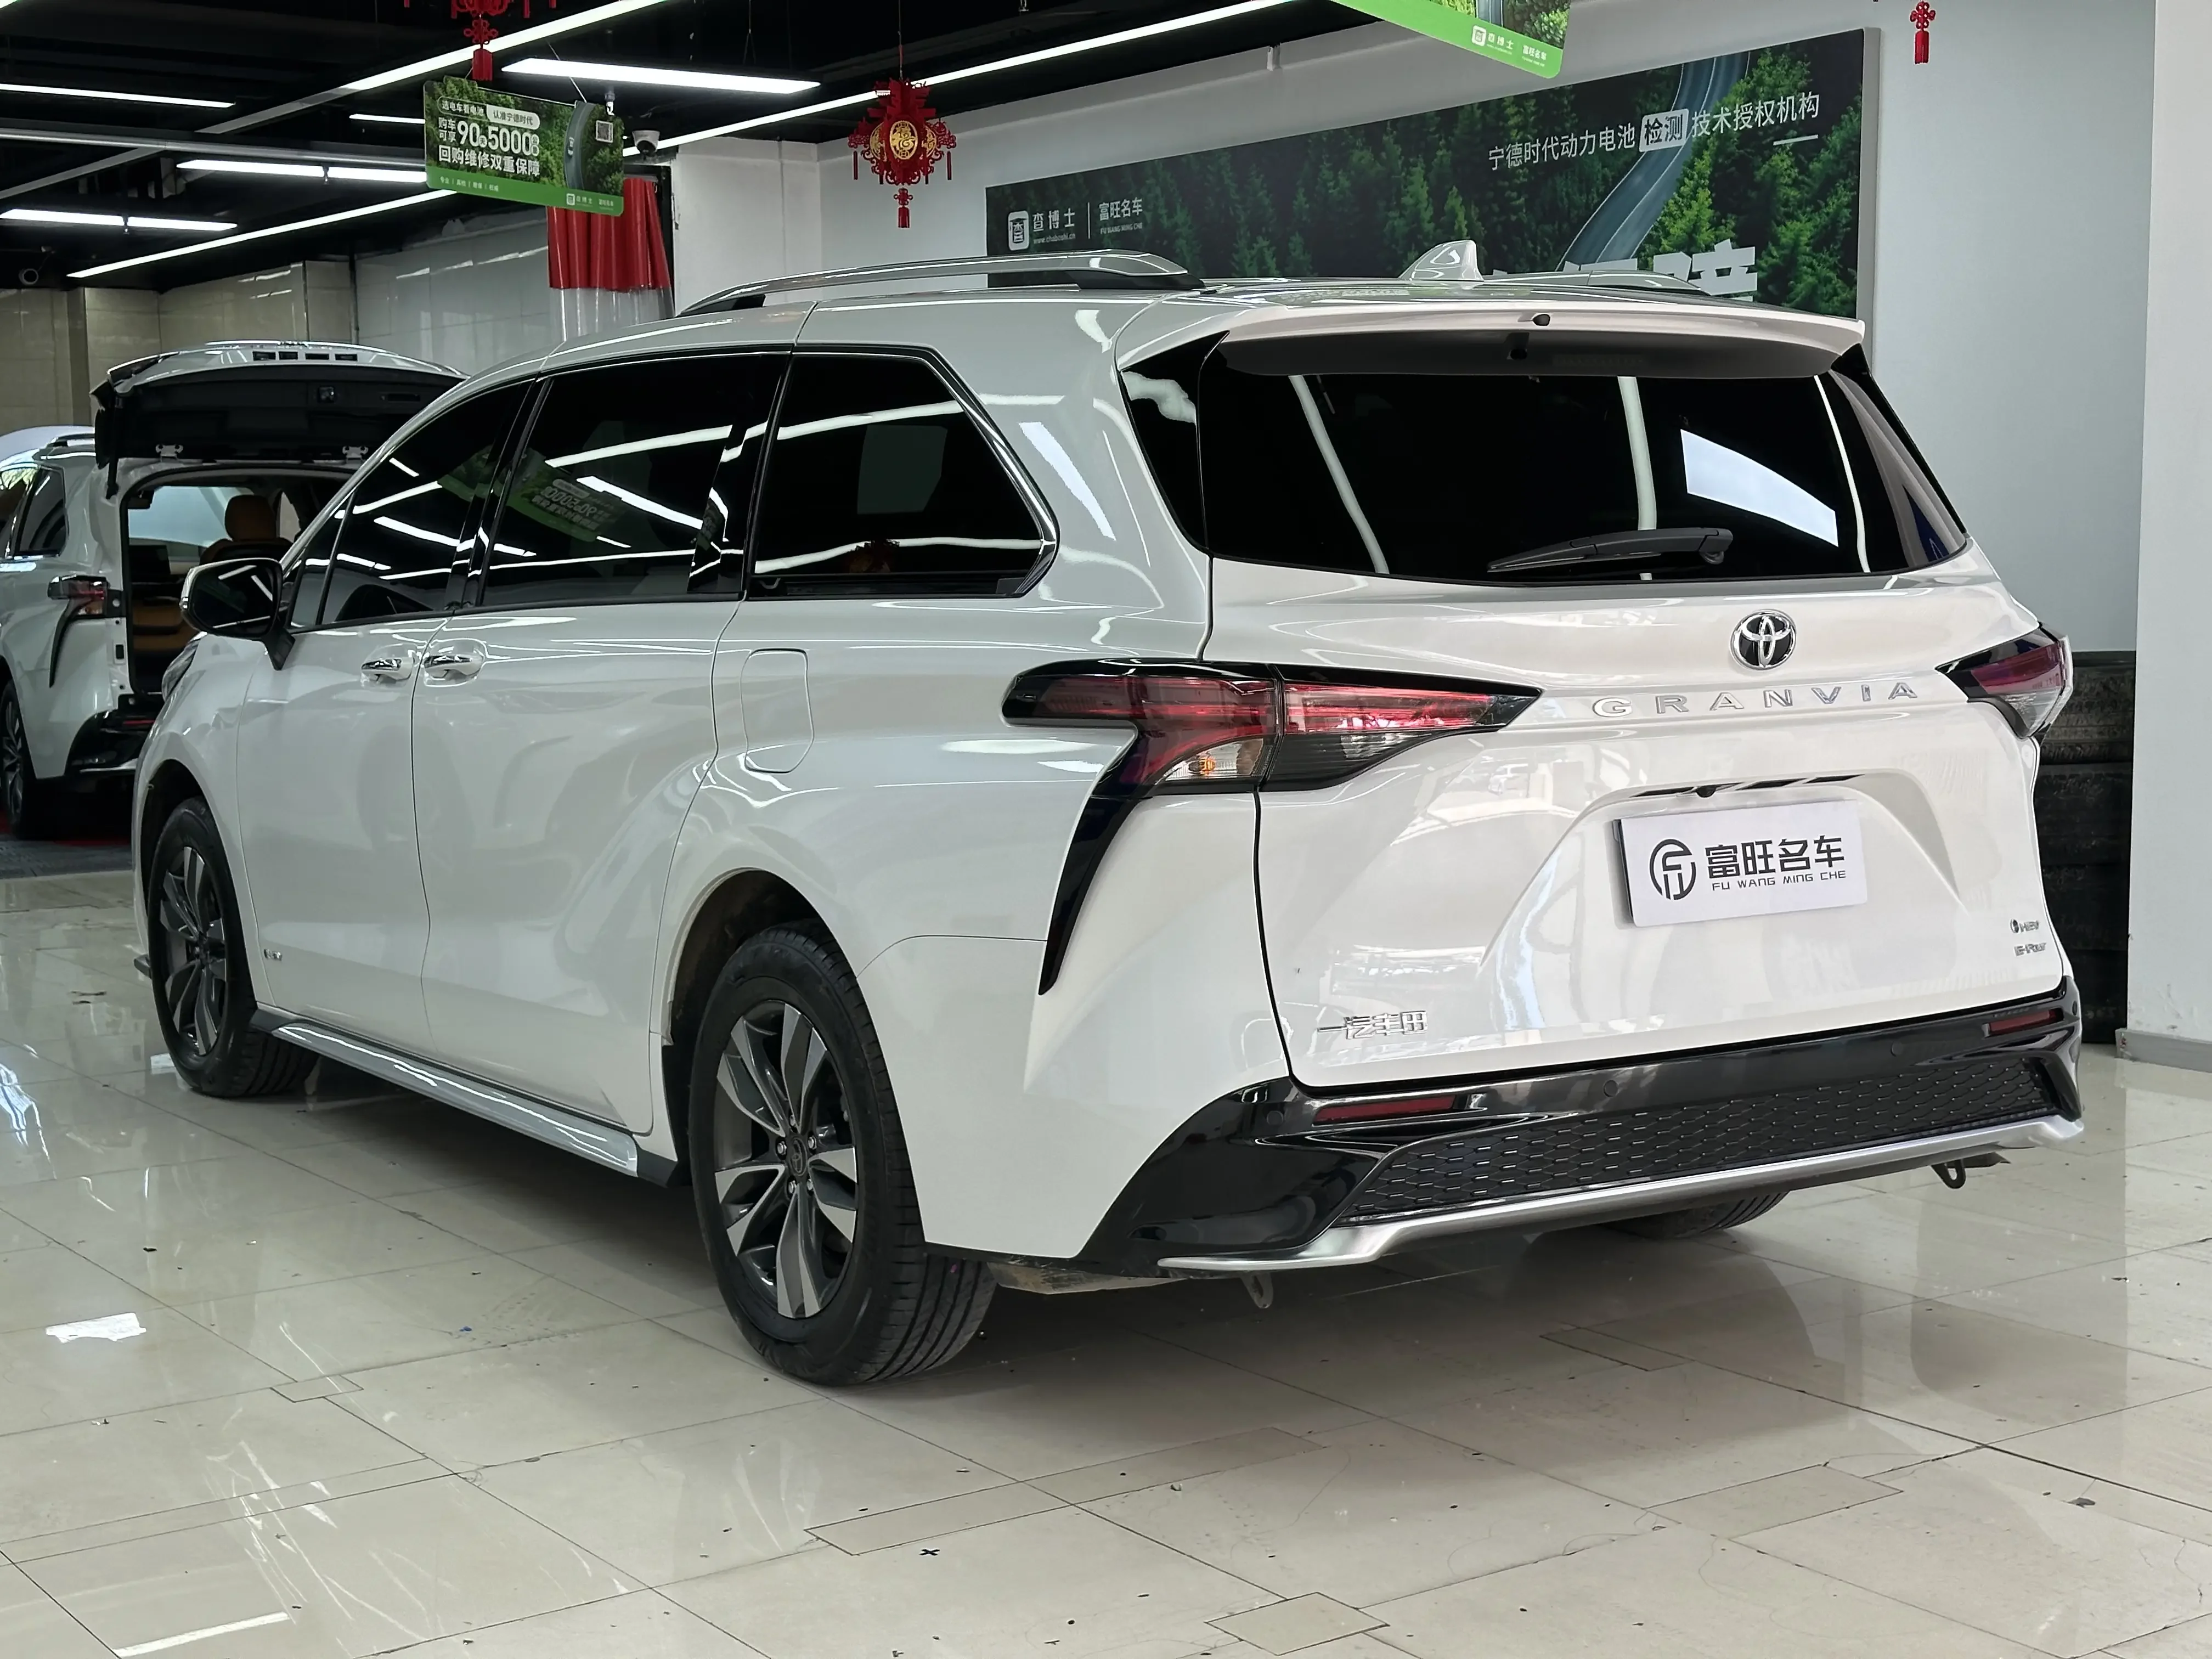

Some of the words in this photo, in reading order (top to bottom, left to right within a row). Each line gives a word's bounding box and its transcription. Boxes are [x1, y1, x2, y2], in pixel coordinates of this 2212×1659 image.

[439, 144, 540, 177] 回购维修双重保障
[1032, 207, 1075, 231] 查博士
[1099, 197, 1143, 221] 富旺名车
[1592, 681, 1918, 718] GRANVIA
[1705, 835, 1844, 878] 富旺名车
[1712, 882, 1730, 891] FU
[1737, 877, 1776, 889] WANG
[1782, 873, 1814, 885] MING
[1820, 870, 1847, 881] CHE
[1317, 1010, 1428, 1040] 一汽丰田
